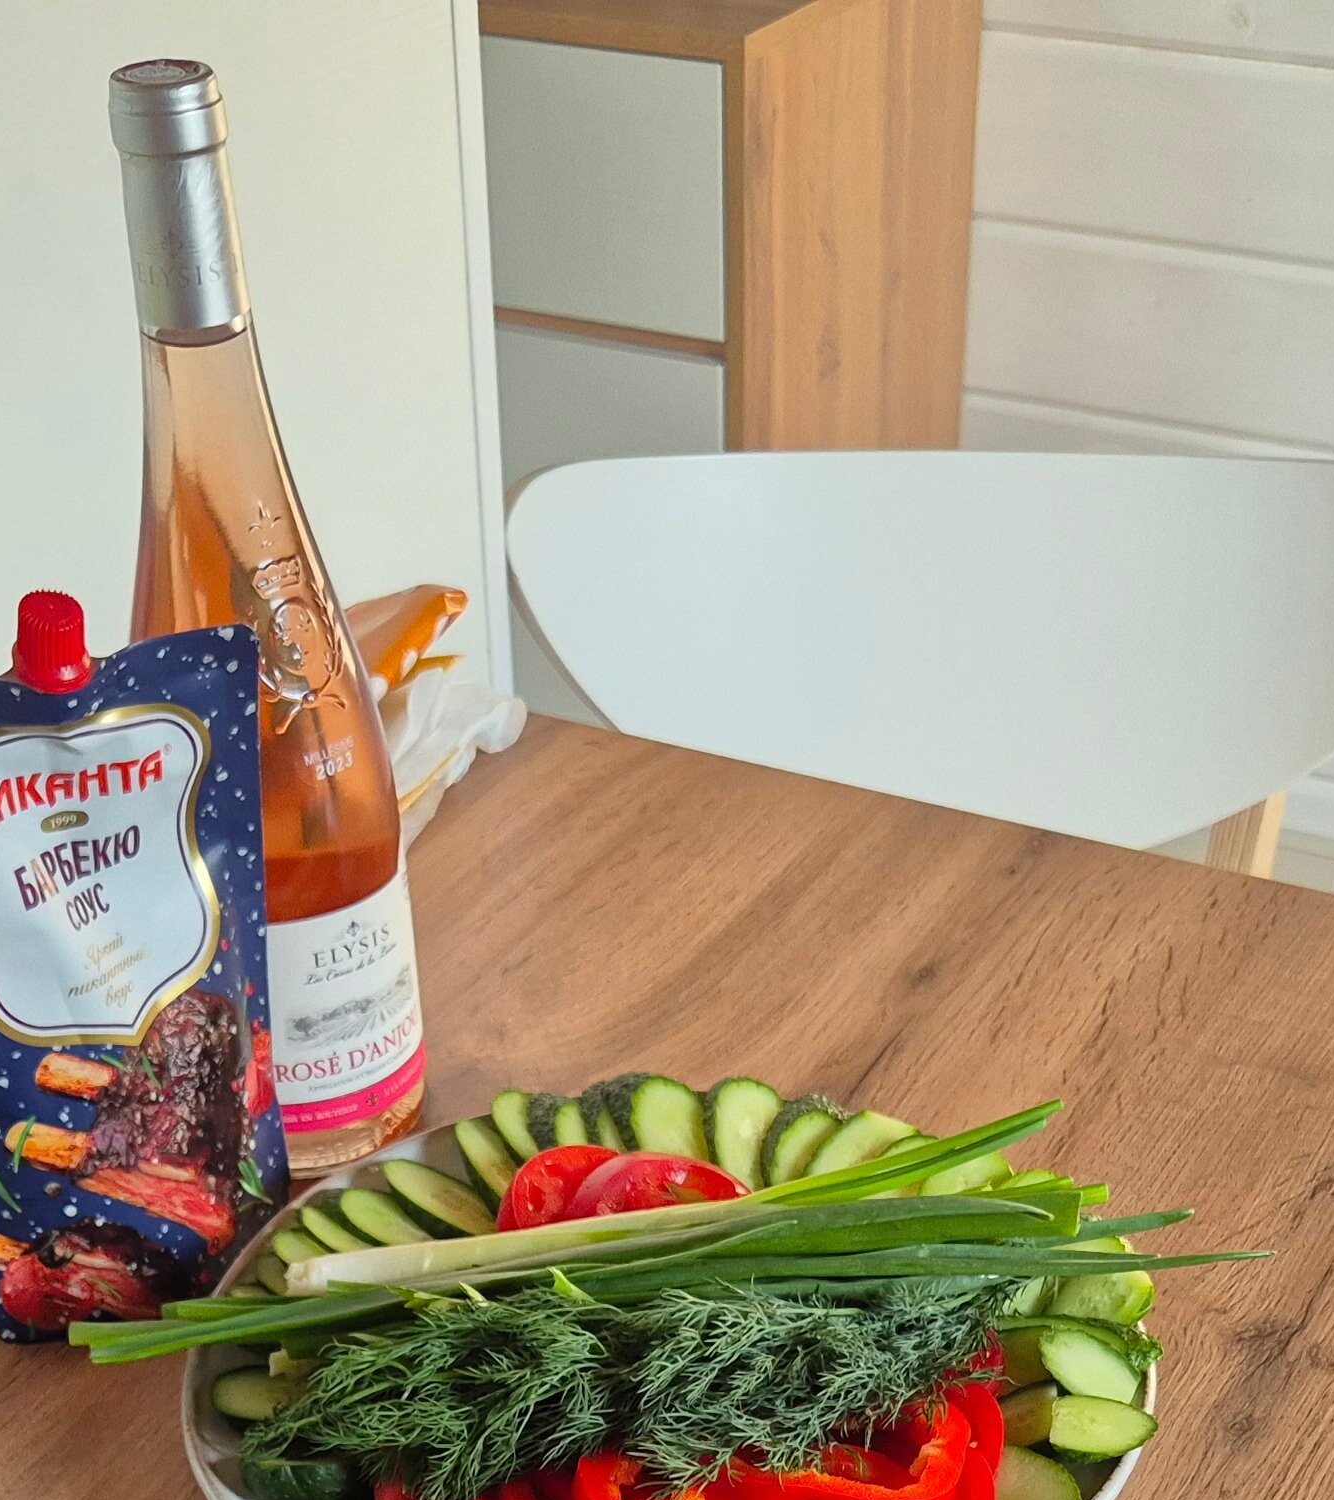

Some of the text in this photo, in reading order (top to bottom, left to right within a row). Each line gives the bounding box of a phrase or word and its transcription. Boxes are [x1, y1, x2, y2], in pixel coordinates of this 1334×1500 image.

[316, 751, 354, 781] 2023
[50, 814, 79, 830] 1999
[13, 824, 141, 912] БАРБЕКЮ
[65, 882, 111, 934] СОУС
[313, 922, 390, 969] ELYSIS
[274, 1051, 343, 1084] ROSÉ
